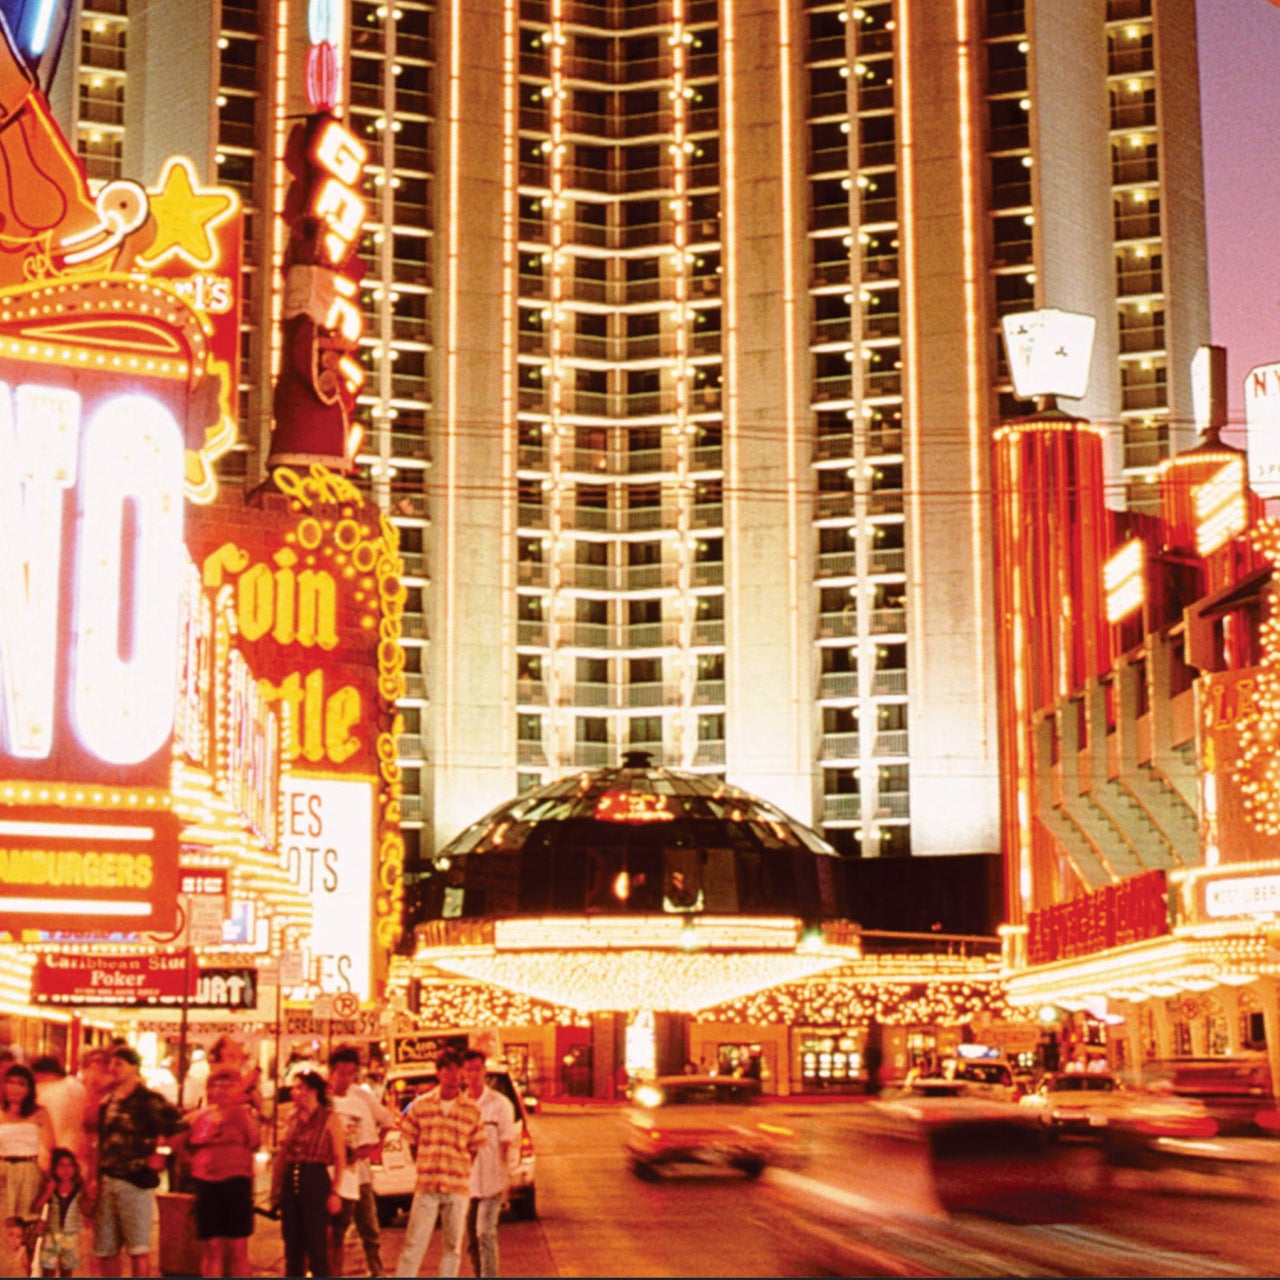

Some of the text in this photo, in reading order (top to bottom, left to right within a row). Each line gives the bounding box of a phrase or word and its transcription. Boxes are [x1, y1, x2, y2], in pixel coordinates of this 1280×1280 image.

[289, 792, 323, 838] ES
[287, 845, 339, 893] OTS
[45, 953, 141, 970] Caribbean
[91, 969, 147, 987] Poker
